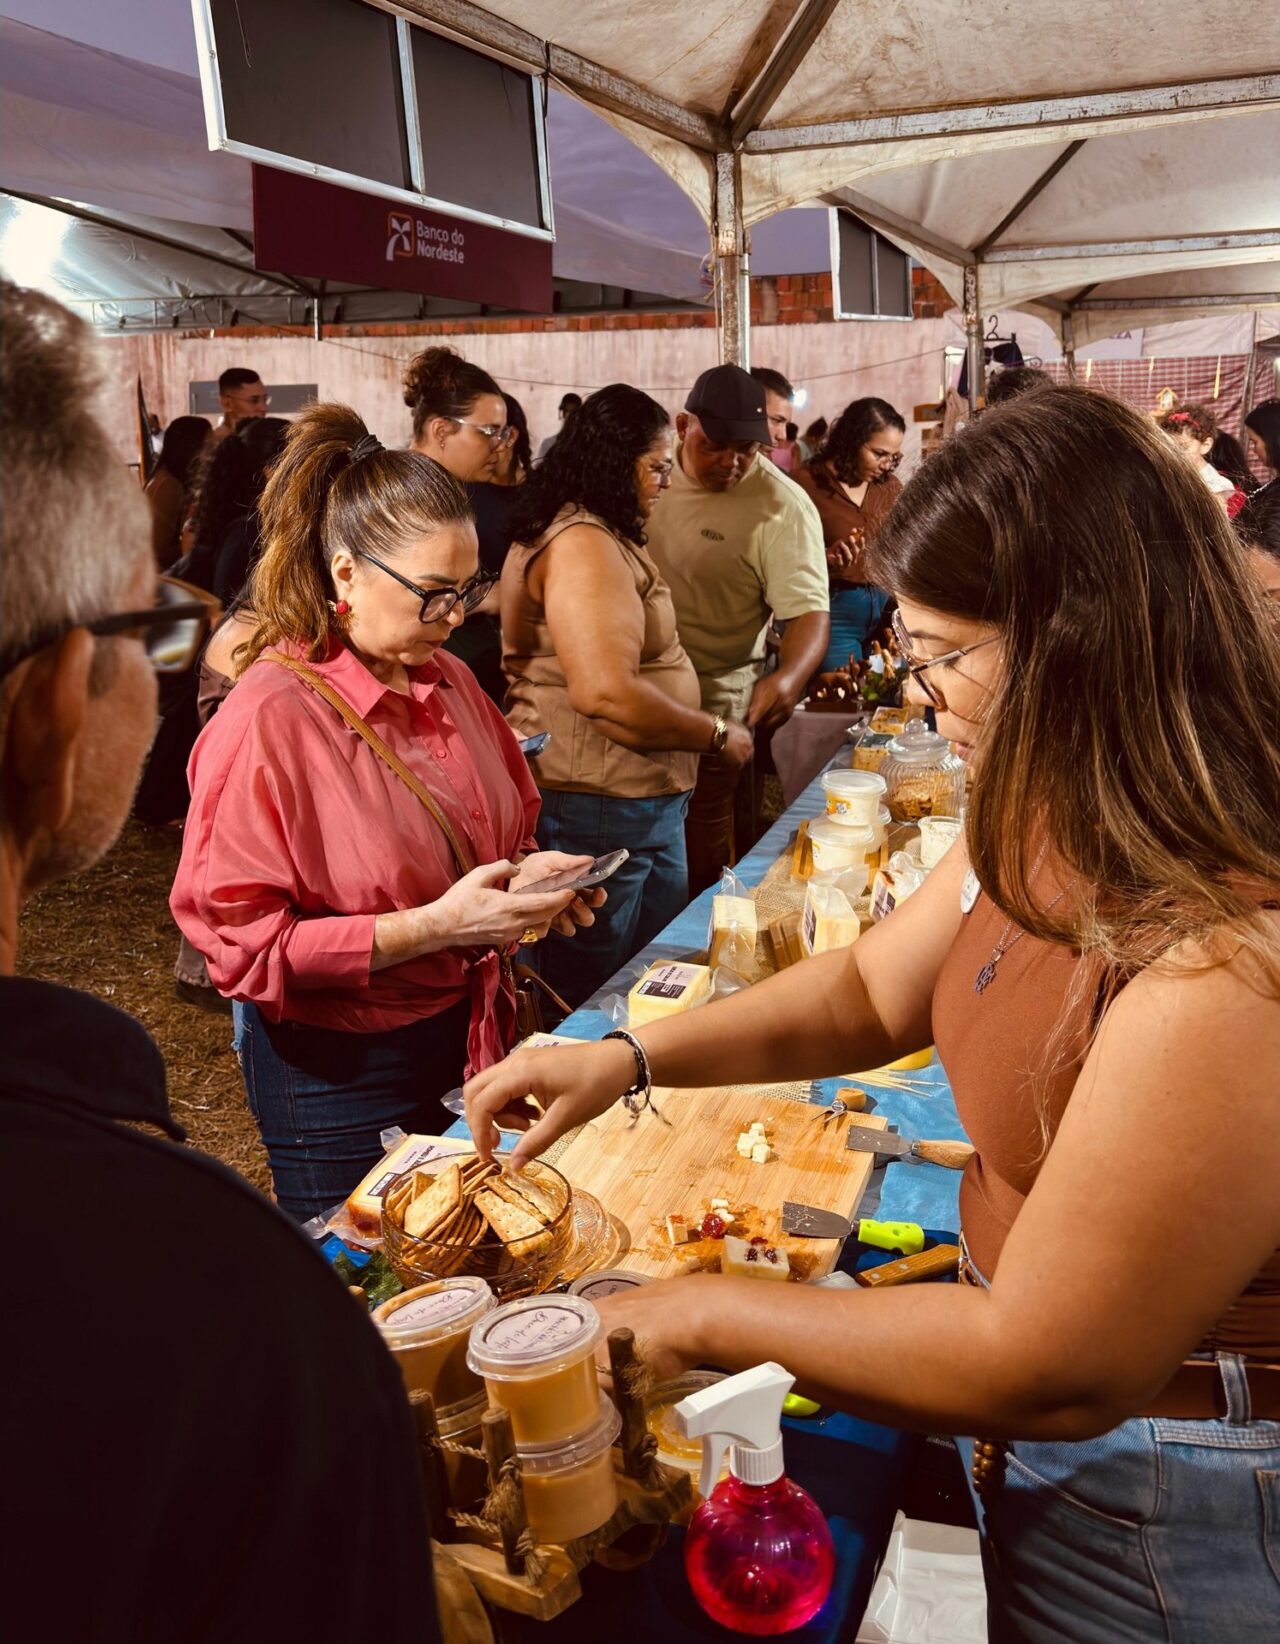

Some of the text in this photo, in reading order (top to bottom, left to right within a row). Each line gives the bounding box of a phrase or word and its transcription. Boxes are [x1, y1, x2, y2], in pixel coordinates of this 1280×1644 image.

[416, 220, 465, 246] Banco do
[416, 239, 465, 264] Nordeste
